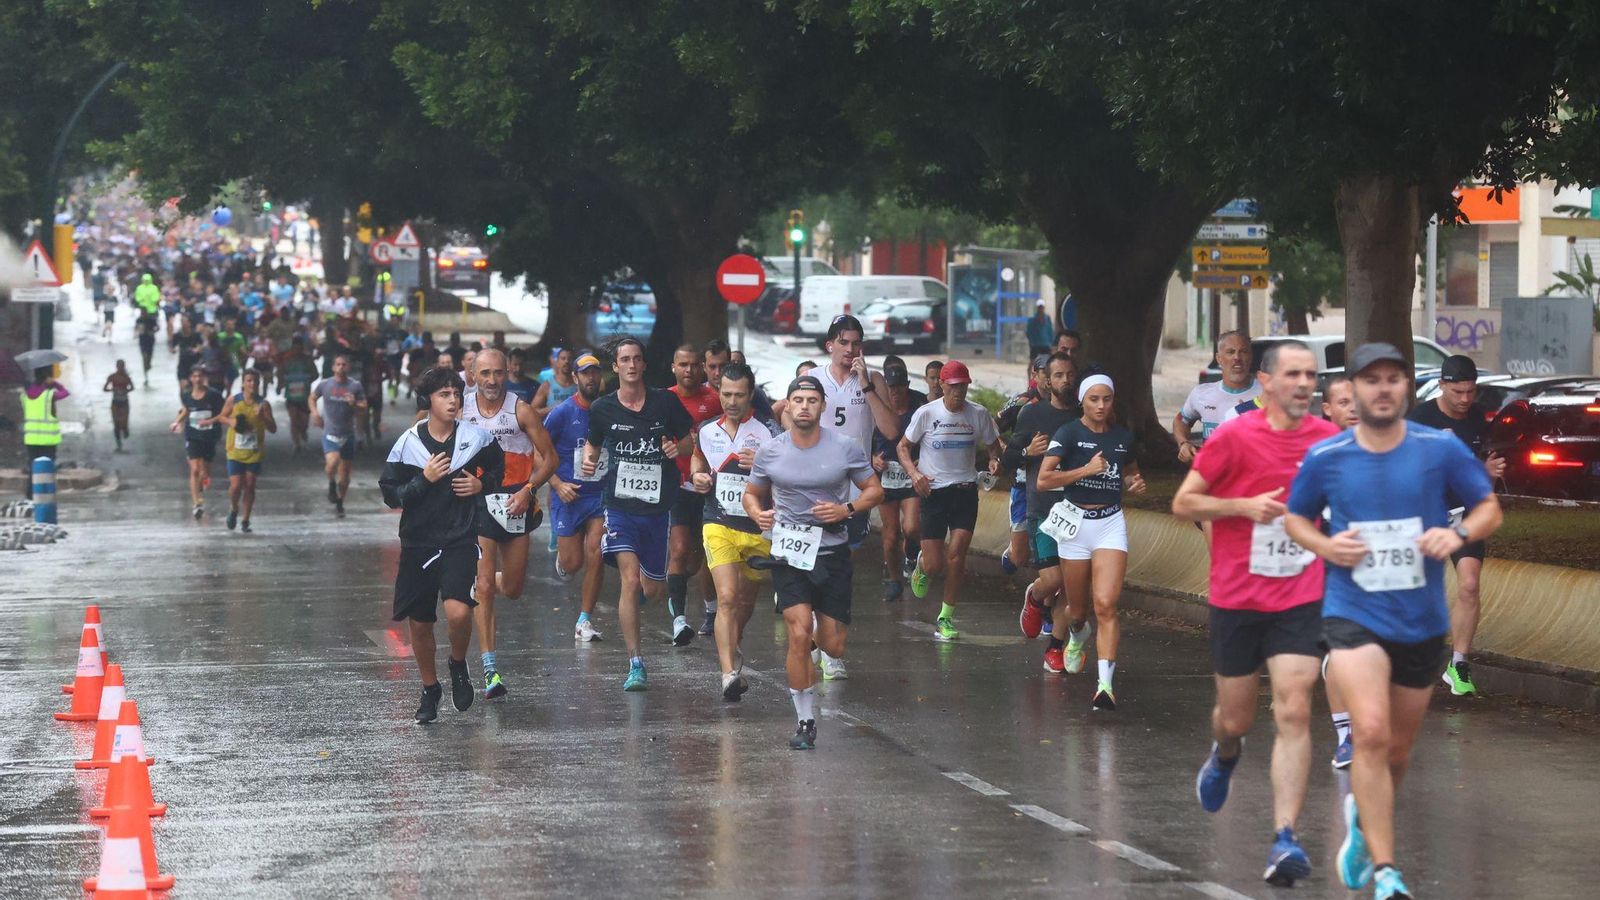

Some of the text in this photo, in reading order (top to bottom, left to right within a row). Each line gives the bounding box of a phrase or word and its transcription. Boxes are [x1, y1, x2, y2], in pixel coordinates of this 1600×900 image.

[834, 406, 846, 427] 5
[489, 428, 515, 437] LHAURIN
[621, 477, 658, 492] 11233
[720, 489, 744, 503] 101
[1100, 504, 1119, 517] NIKE
[780, 537, 811, 555] 1297
[1266, 540, 1304, 557] 145
